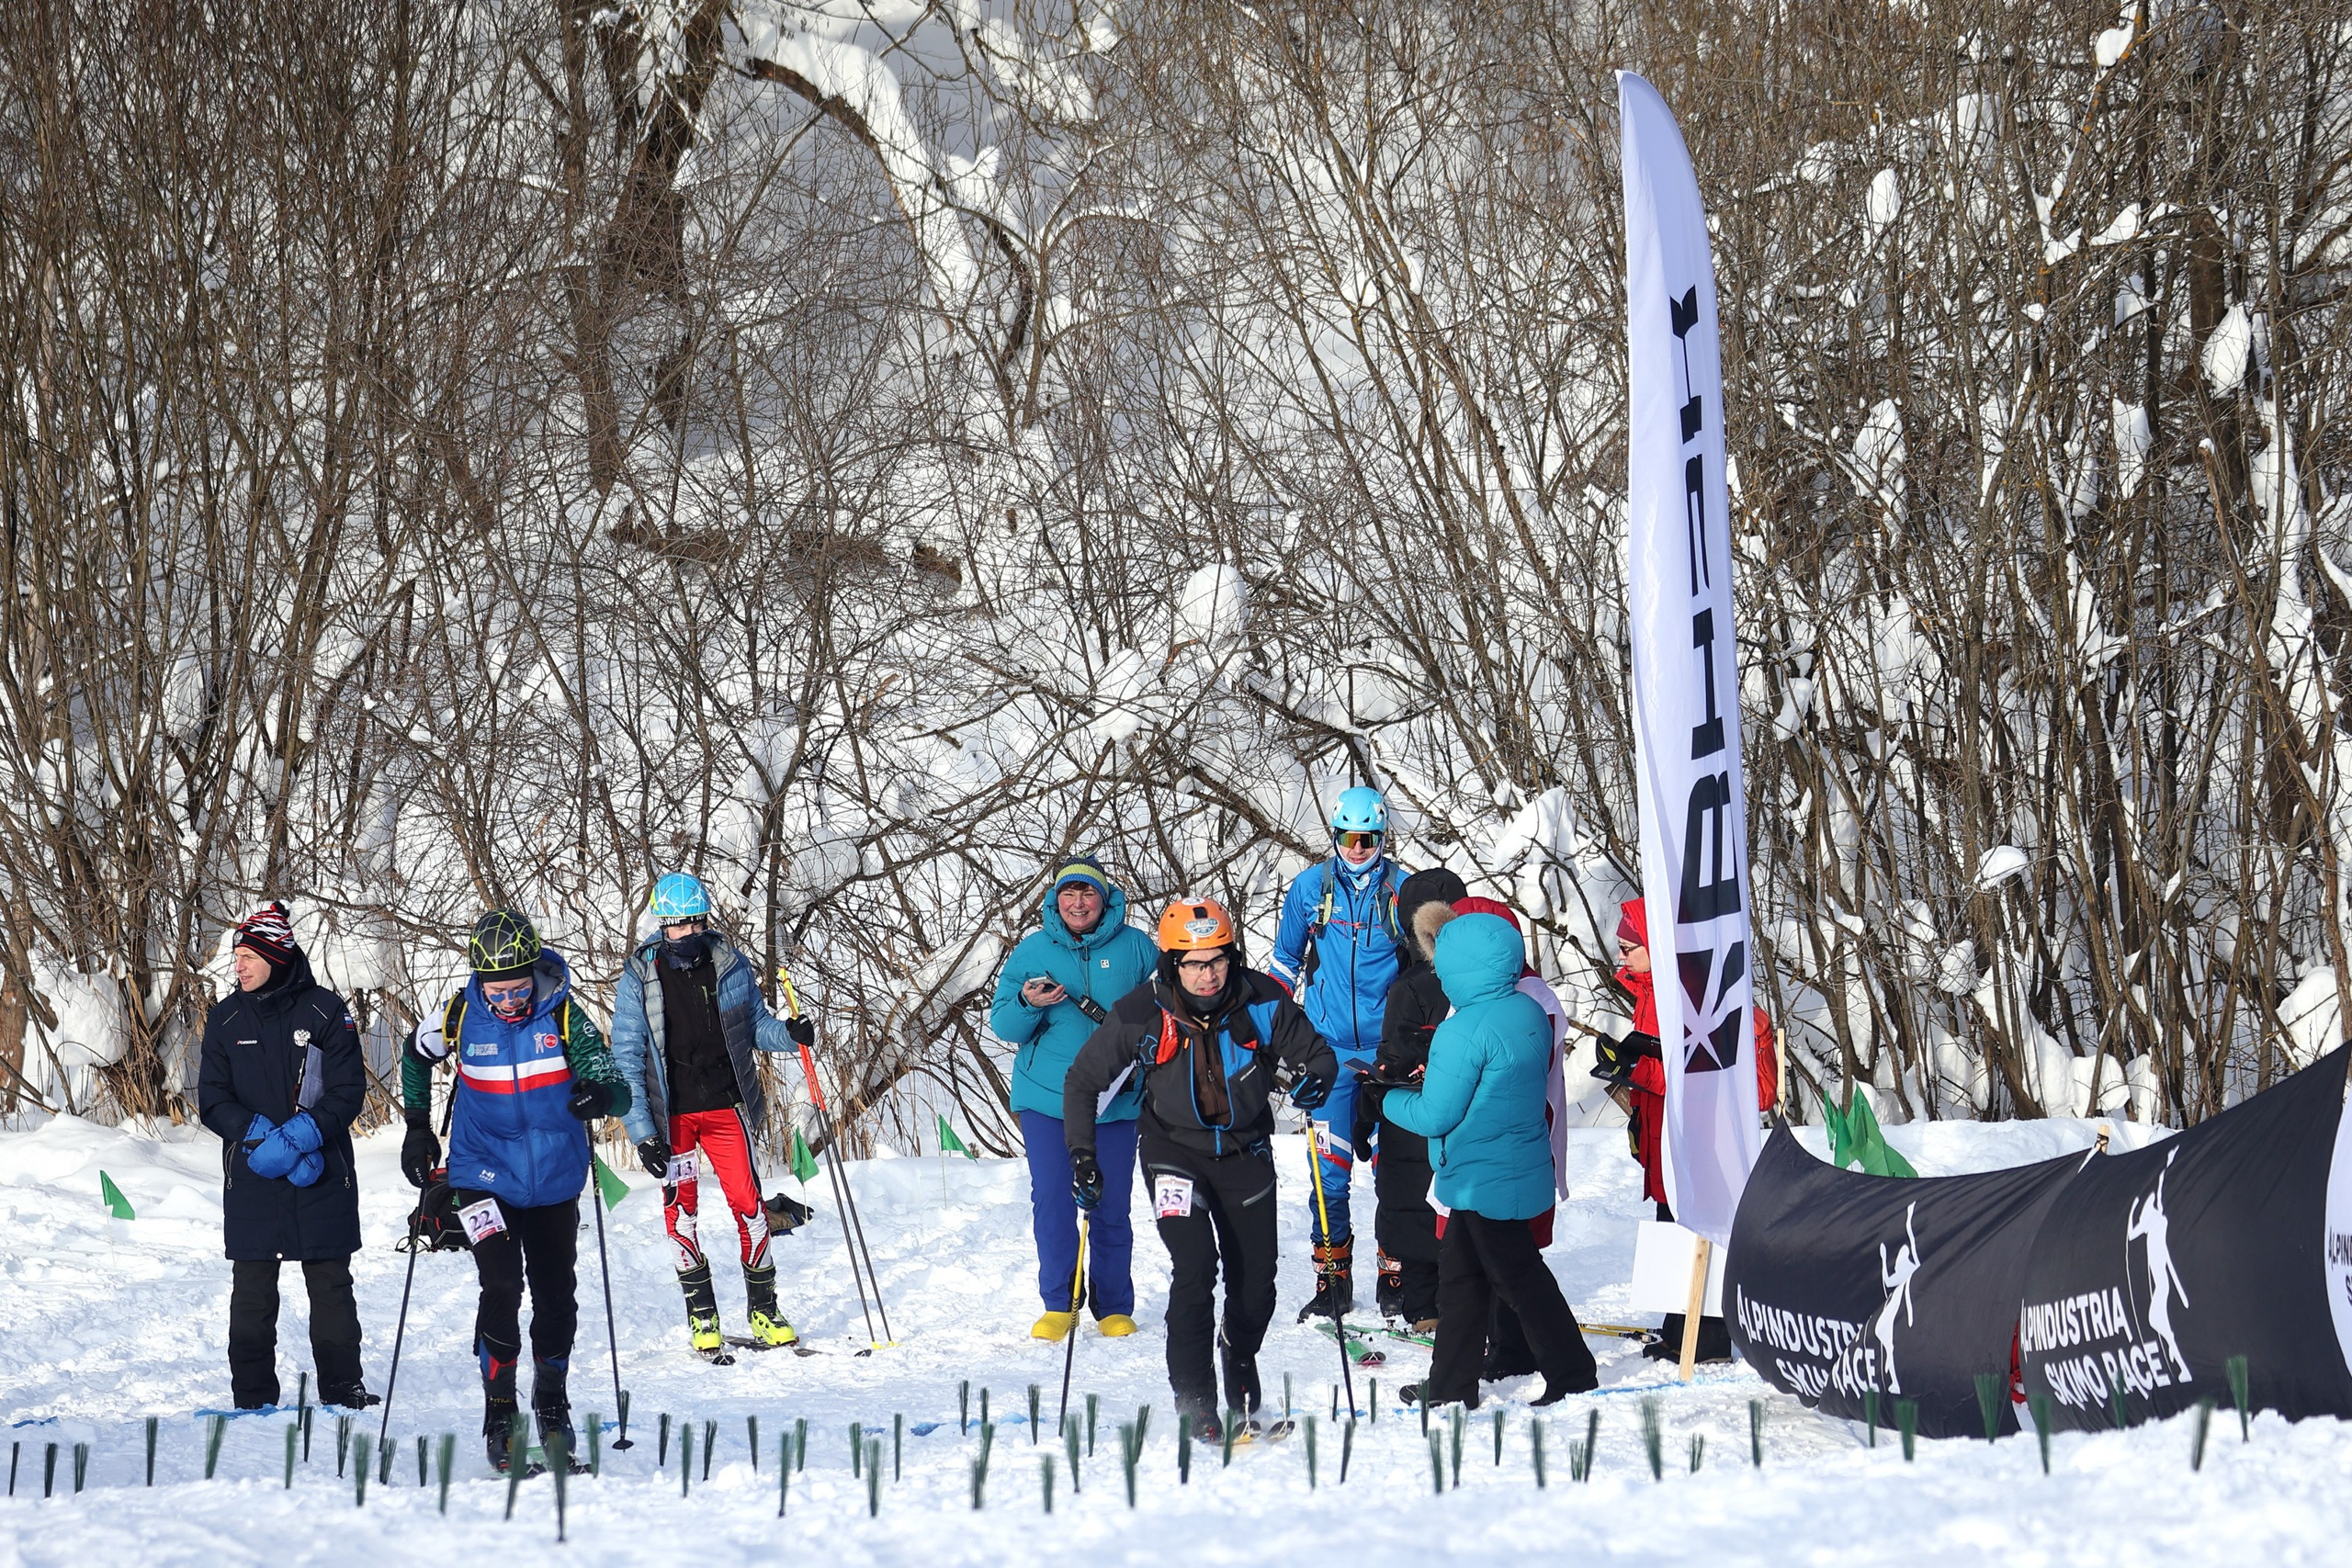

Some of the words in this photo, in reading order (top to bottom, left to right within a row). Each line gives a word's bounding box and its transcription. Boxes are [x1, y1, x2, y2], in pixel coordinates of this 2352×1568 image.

[1316, 1130, 1324, 1145] 6
[675, 1160, 693, 1177] 13
[1159, 1188, 1184, 1207] 35
[468, 1210, 494, 1232] 22
[1737, 1283, 1864, 1359] ALPINDUSTR
[2020, 1286, 2133, 1364] ALPINDUSTRIA
[2044, 1354, 2108, 1412] SKIMO
[2101, 1340, 2172, 1401] RACE
